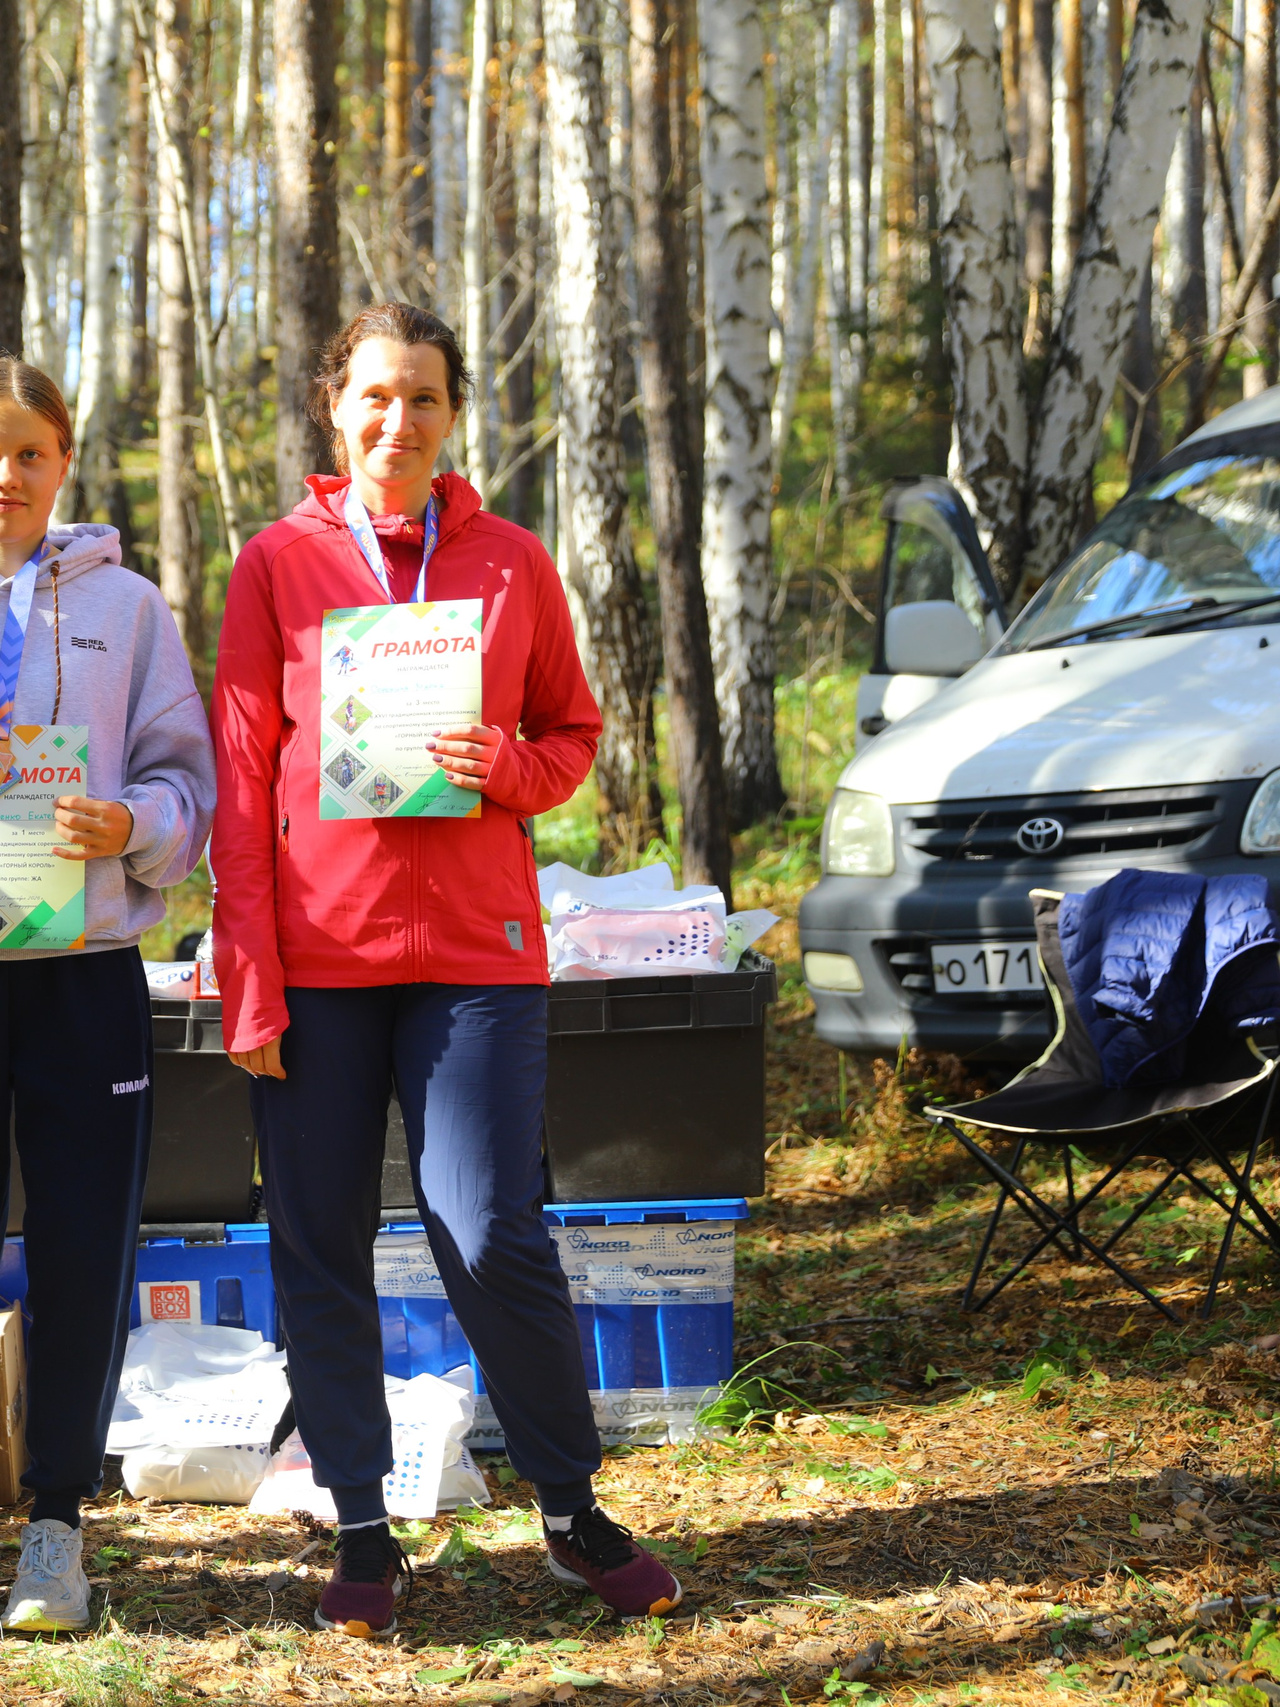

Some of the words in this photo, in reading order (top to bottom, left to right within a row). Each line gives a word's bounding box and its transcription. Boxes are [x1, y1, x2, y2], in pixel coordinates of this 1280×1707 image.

[371, 636, 476, 658] ГРАМОТА
[580, 1240, 630, 1249] NORD
[655, 1268, 707, 1276] NORD
[154, 1290, 187, 1302] ROX
[630, 1289, 680, 1297] NORD
[155, 1302, 187, 1314] BOX
